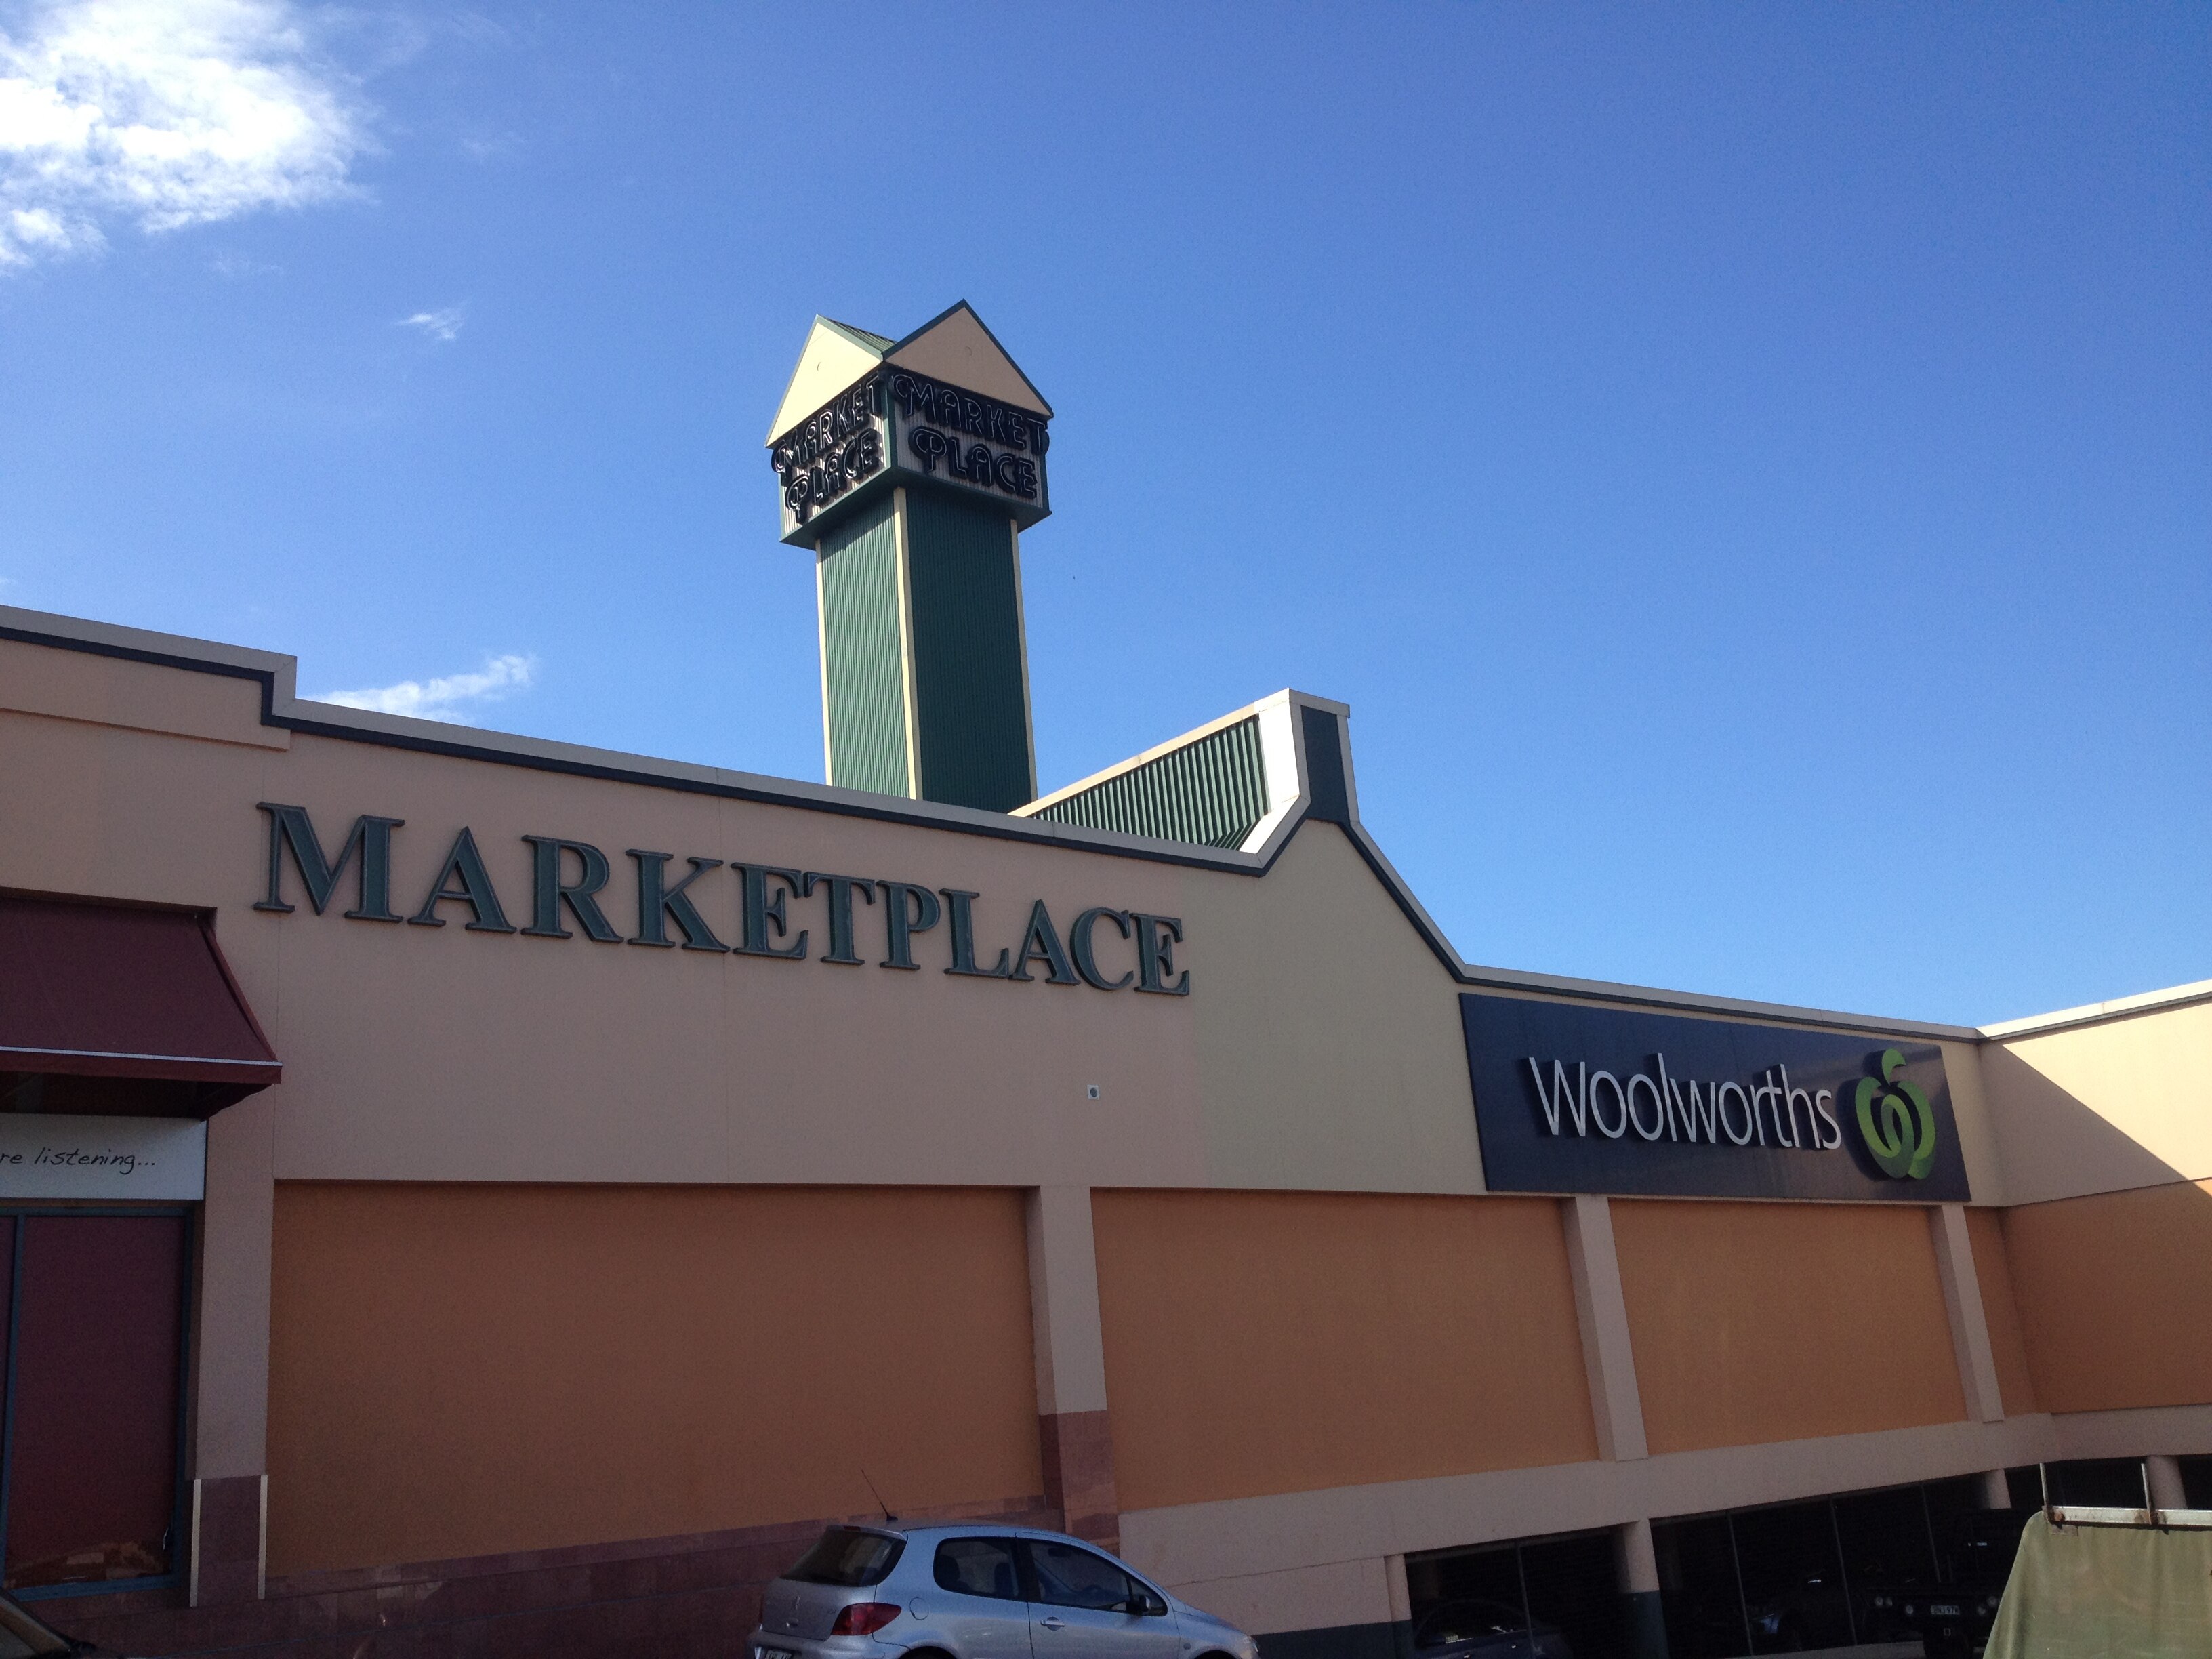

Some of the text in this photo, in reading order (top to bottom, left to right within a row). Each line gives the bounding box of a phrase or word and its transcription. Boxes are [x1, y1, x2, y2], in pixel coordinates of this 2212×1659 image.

[771, 371, 883, 485] MARKET
[890, 373, 1048, 455] MARKET
[785, 429, 881, 524] PLACE
[908, 426, 1038, 499] PLACE
[252, 801, 1191, 996] MARKETPLACE
[1528, 1053, 1842, 1150] Woolworths
[34, 1147, 155, 1175] listening...
